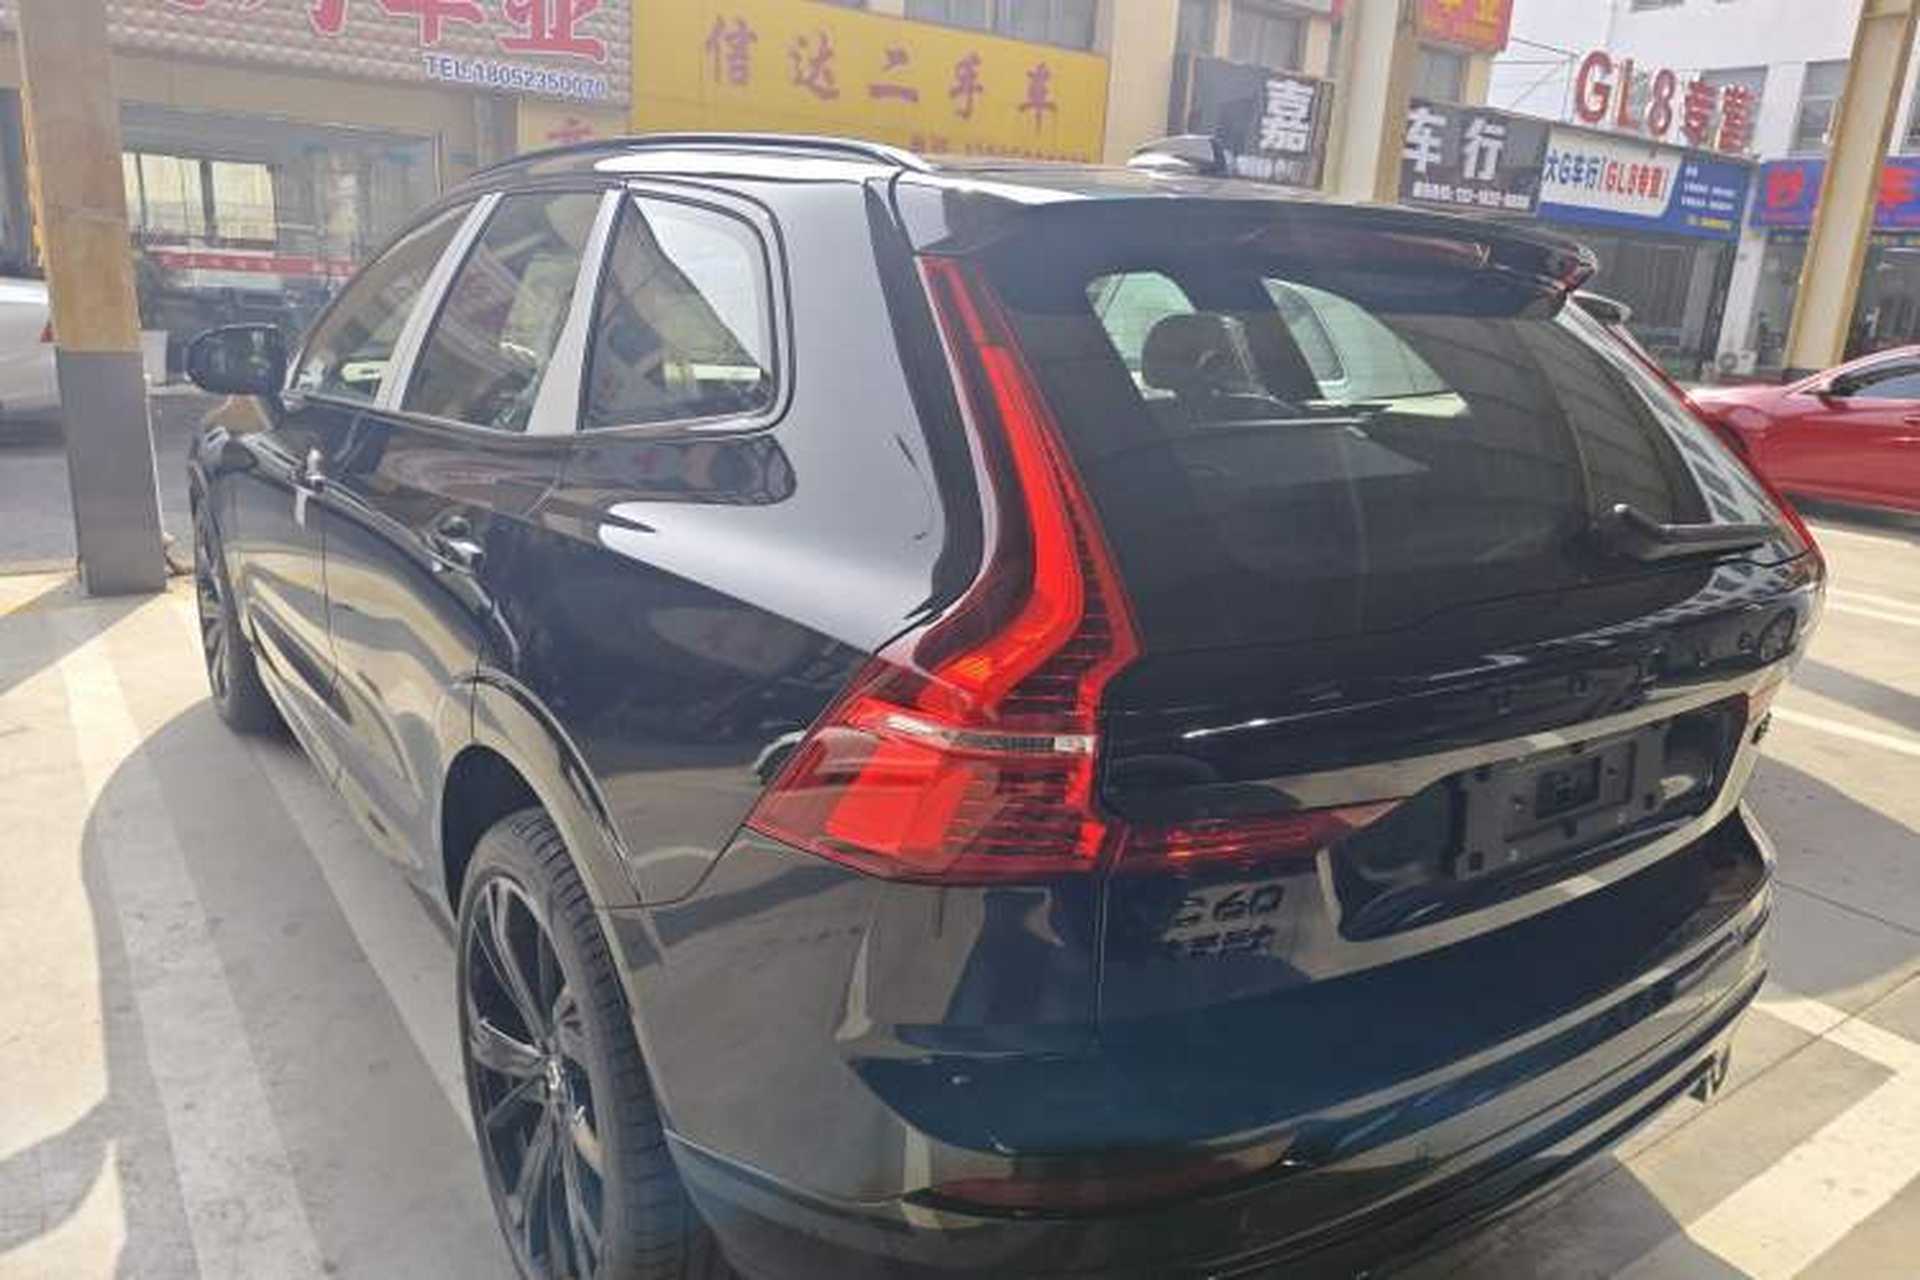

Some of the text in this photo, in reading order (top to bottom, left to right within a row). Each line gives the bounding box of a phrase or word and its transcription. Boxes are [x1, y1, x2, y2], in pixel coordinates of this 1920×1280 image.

[706, 15, 1058, 135] 信达二手车
[1260, 79, 1314, 152] 嘉
[1402, 106, 1508, 181] 车行
